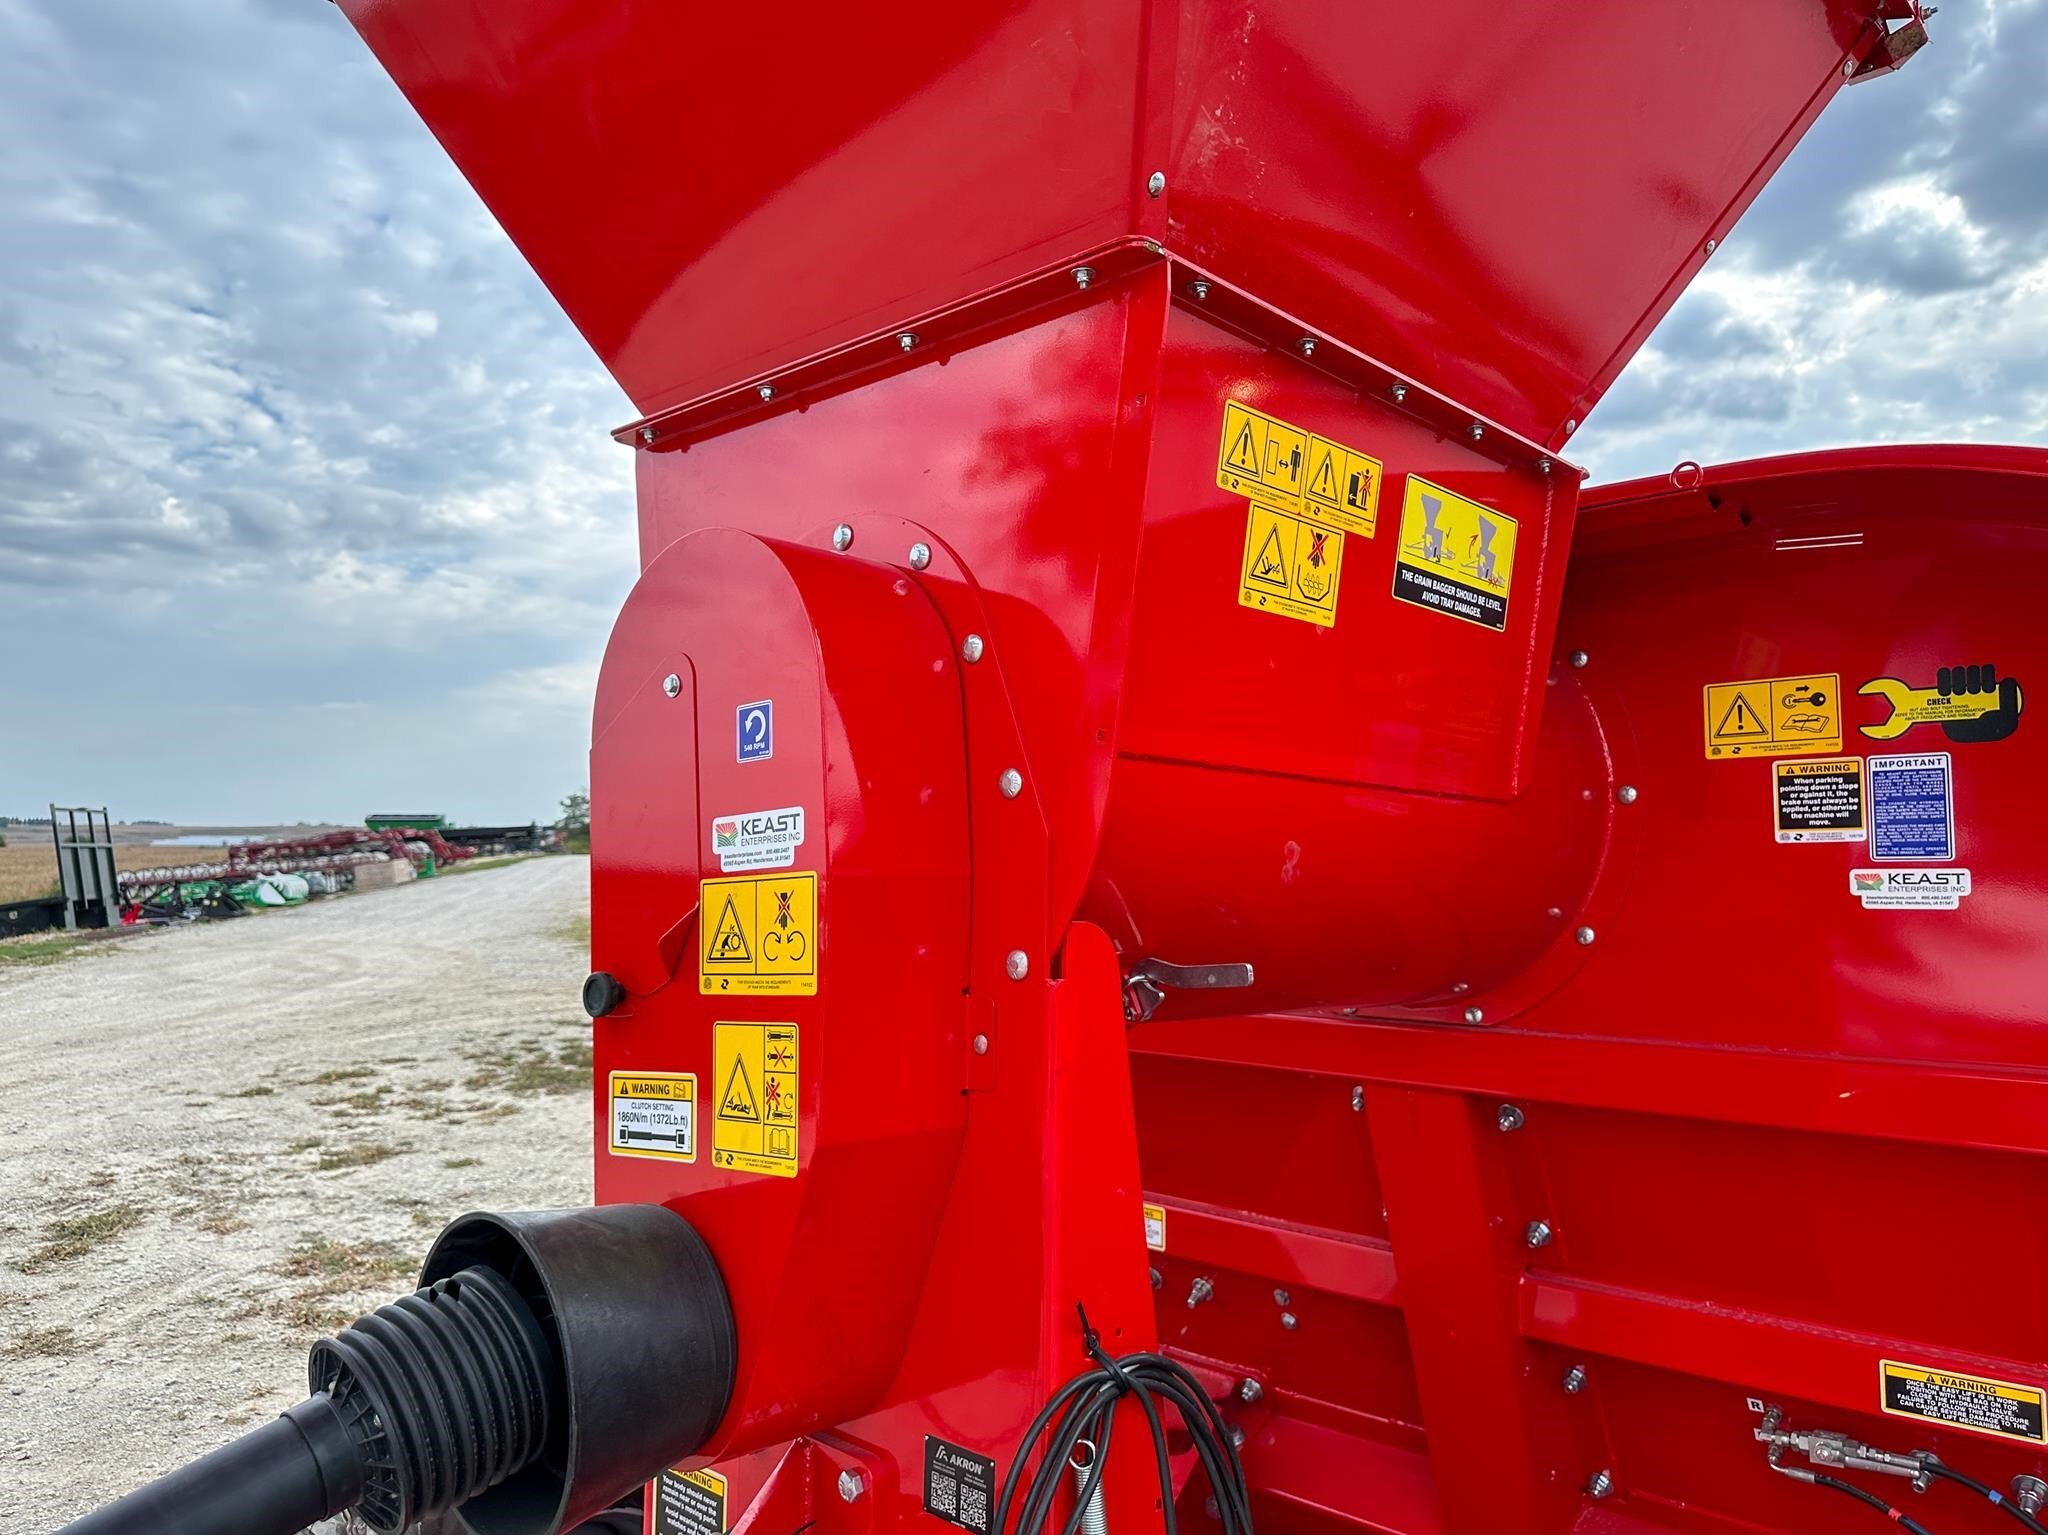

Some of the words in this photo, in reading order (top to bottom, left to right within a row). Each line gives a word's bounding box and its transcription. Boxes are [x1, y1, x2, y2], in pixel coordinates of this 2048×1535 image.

[1401, 569, 1413, 582] THE
[1414, 573, 1432, 589] GRAIN
[1432, 580, 1456, 596] BAGGER
[1456, 588, 1478, 603] SHOULD
[1478, 595, 1486, 606] BE
[1486, 598, 1502, 612] LEVEL.
[1422, 590, 1440, 605] AVOID
[1440, 597, 1455, 609] TRAY
[1454, 601, 1481, 618] DAMAGES.
[1926, 697, 1951, 706] CHECK
[1799, 763, 1850, 774] WARNING
[1874, 758, 1942, 768] IMPORTANT
[1780, 784, 1809, 793] pointing
[1810, 783, 1830, 791] down
[1838, 782, 1859, 790] slope
[1815, 776, 1843, 784] parking
[1781, 798, 1801, 806] brake
[1802, 797, 1821, 805] must
[1822, 797, 1847, 805] always
[1848, 796, 1859, 804] be
[1799, 790, 1826, 799] against
[1836, 789, 1848, 797] the
[1782, 805, 1811, 813] applied,
[1791, 811, 1803, 819] the
[1804, 810, 1835, 818] machine
[741, 813, 800, 836] KEAST
[741, 833, 787, 847] ENTERPRISES
[788, 831, 801, 841] INC
[1888, 873, 1965, 885] KEAST
[632, 1083, 670, 1095] WARNING
[632, 1102, 652, 1111] CLUTCH
[652, 1102, 675, 1112] SETTING
[618, 1111, 648, 1123] 1860N/m
[649, 1112, 688, 1129] (1372Lb.ft)
[1906, 1379, 1925, 1388] ONCE
[1927, 1383, 1940, 1391] THE
[1942, 1386, 1959, 1395] EASY
[1962, 1390, 1976, 1398] LIFT
[1997, 1397, 2018, 1406] WORK
[1940, 1376, 1997, 1394] WARNING
[1906, 1384, 1937, 1396] POSITION
[1939, 1391, 1956, 1399] WITH
[1958, 1394, 1972, 1402] THE
[1973, 1398, 1988, 1406] BAG
[1750, 1400, 1761, 1410] R
[1897, 1393, 1925, 1404] FAILURE
[1938, 1402, 1966, 1412] FOLLOW
[1985, 1411, 2030, 1425] PROCEDURE
[1910, 1391, 1932, 1401] CLOSE
[1935, 1395, 1948, 1403] THE
[1950, 1398, 1989, 1411] HYDRAULIC
[1990, 1407, 2014, 1417] VALVE.
[1900, 1399, 1914, 1407] CAN
[1915, 1402, 1938, 1412] CAUSE
[1940, 1407, 1967, 1417] SEVERE
[1969, 1413, 1999, 1425] DAMAGE
[2013, 1422, 2028, 1431] THE
[1923, 1409, 1941, 1418] EASY
[1943, 1413, 1957, 1421] LIFT
[1958, 1417, 2002, 1431] MECHANISM.
[949, 1454, 982, 1475] AKRON
[680, 1471, 712, 1488] ARNING
[662, 1474, 674, 1486] Your
[673, 1480, 686, 1494] body
[686, 1487, 703, 1500] should
[703, 1496, 718, 1507] never
[662, 1485, 679, 1497] remain
[679, 1493, 690, 1503] near
[690, 1498, 697, 1506] or
[696, 1502, 708, 1512] over
[708, 1506, 717, 1517] the
[665, 1505, 679, 1519] Avoid
[679, 1514, 698, 1530] wearing
[684, 1504, 703, 1521] moving
[667, 1516, 687, 1532] watches
